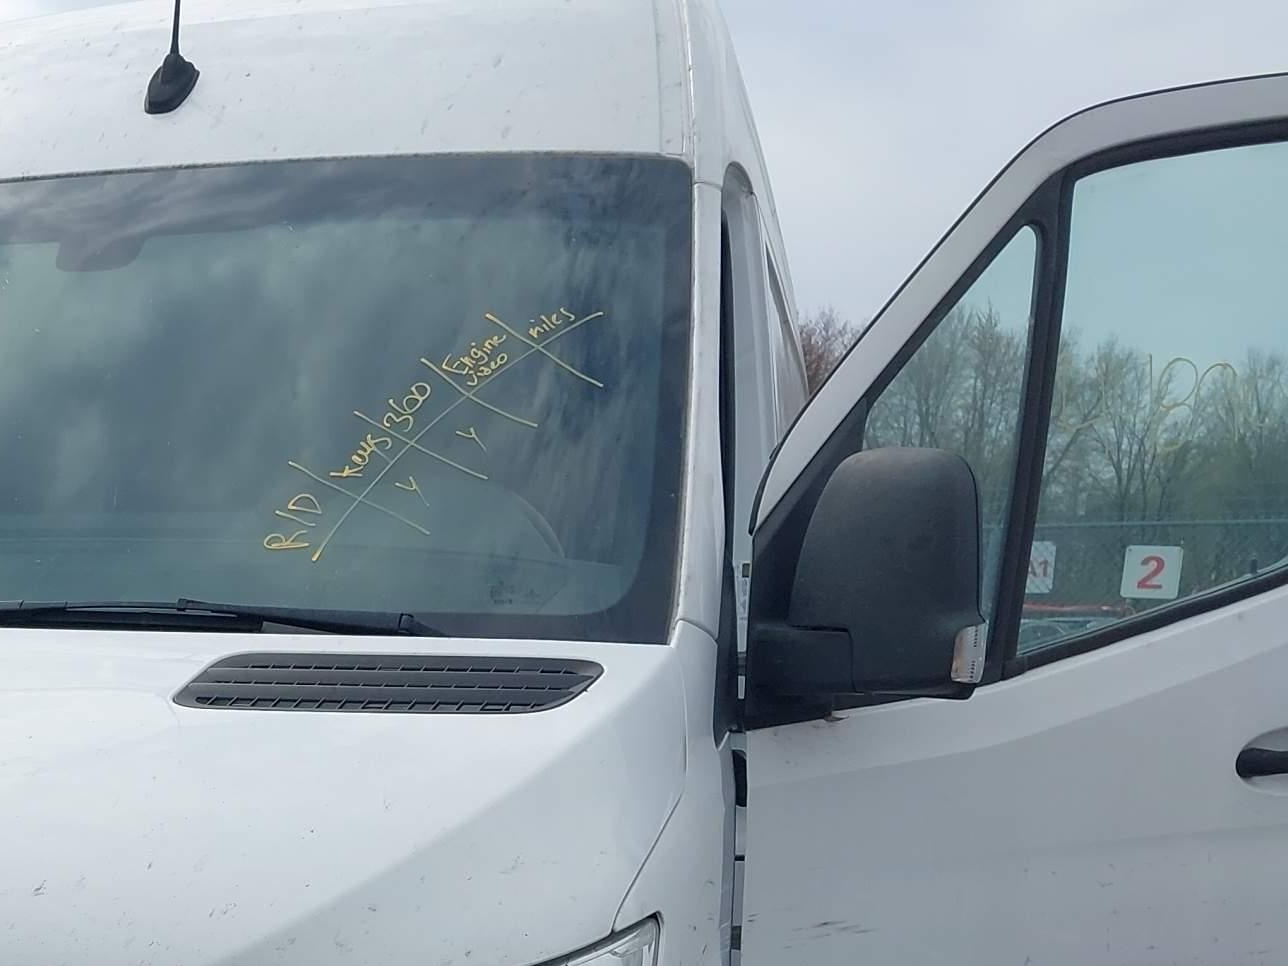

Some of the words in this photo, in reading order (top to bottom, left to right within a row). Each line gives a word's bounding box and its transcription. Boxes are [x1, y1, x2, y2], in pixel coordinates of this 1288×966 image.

[441, 334, 506, 375] Engine
[383, 382, 431, 433] 360
[1136, 555, 1166, 590] 2
